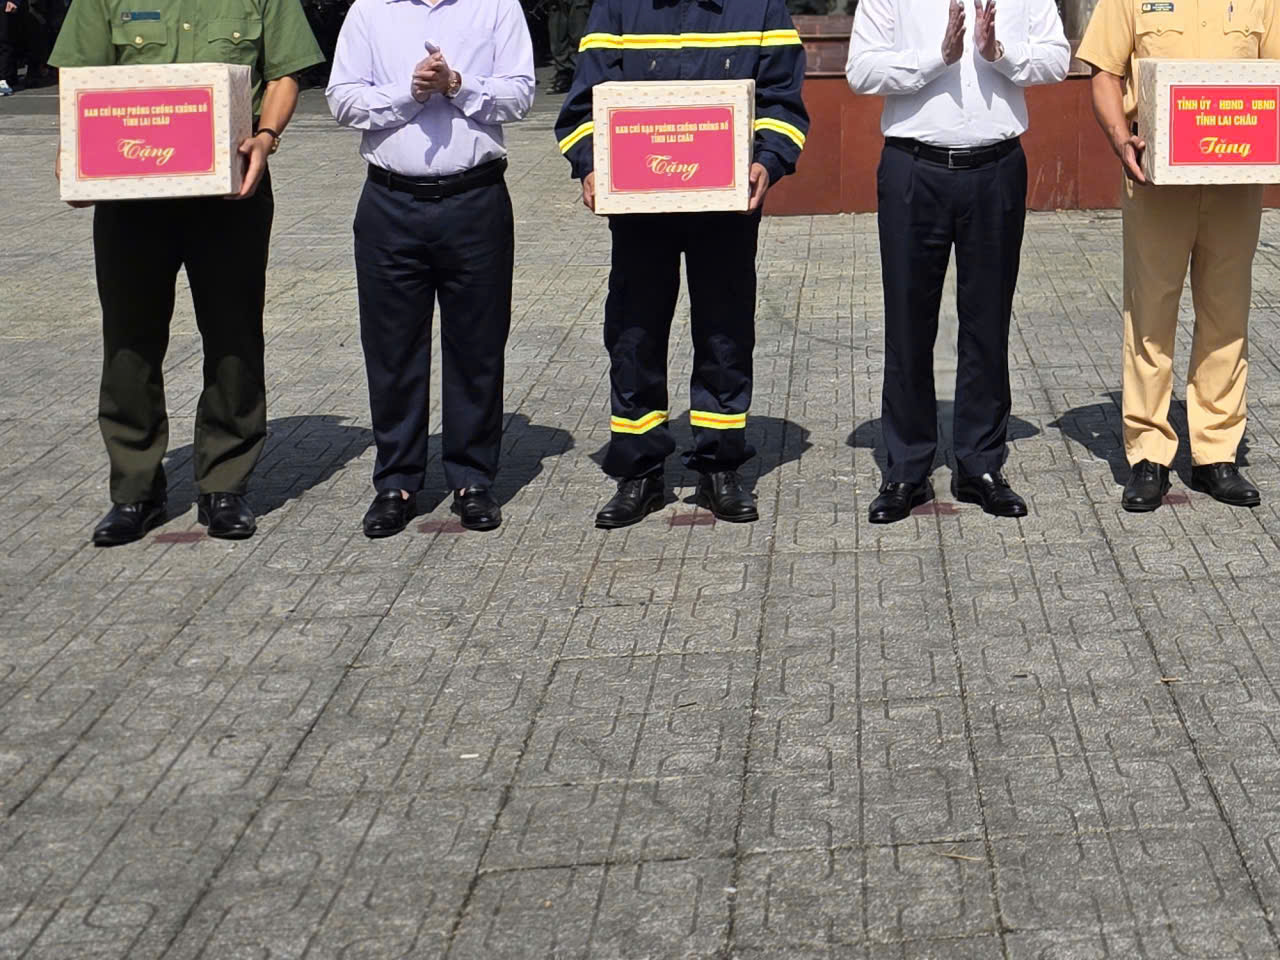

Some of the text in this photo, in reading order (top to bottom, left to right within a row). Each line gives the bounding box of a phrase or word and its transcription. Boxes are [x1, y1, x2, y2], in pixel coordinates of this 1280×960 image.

[1251, 99, 1276, 110] UBND
[1195, 112, 1258, 126] TỈNH LAI CHÂU
[117, 138, 175, 166] Tặng
[1199, 136, 1251, 158] Tặng
[646, 154, 699, 182] Tặng
